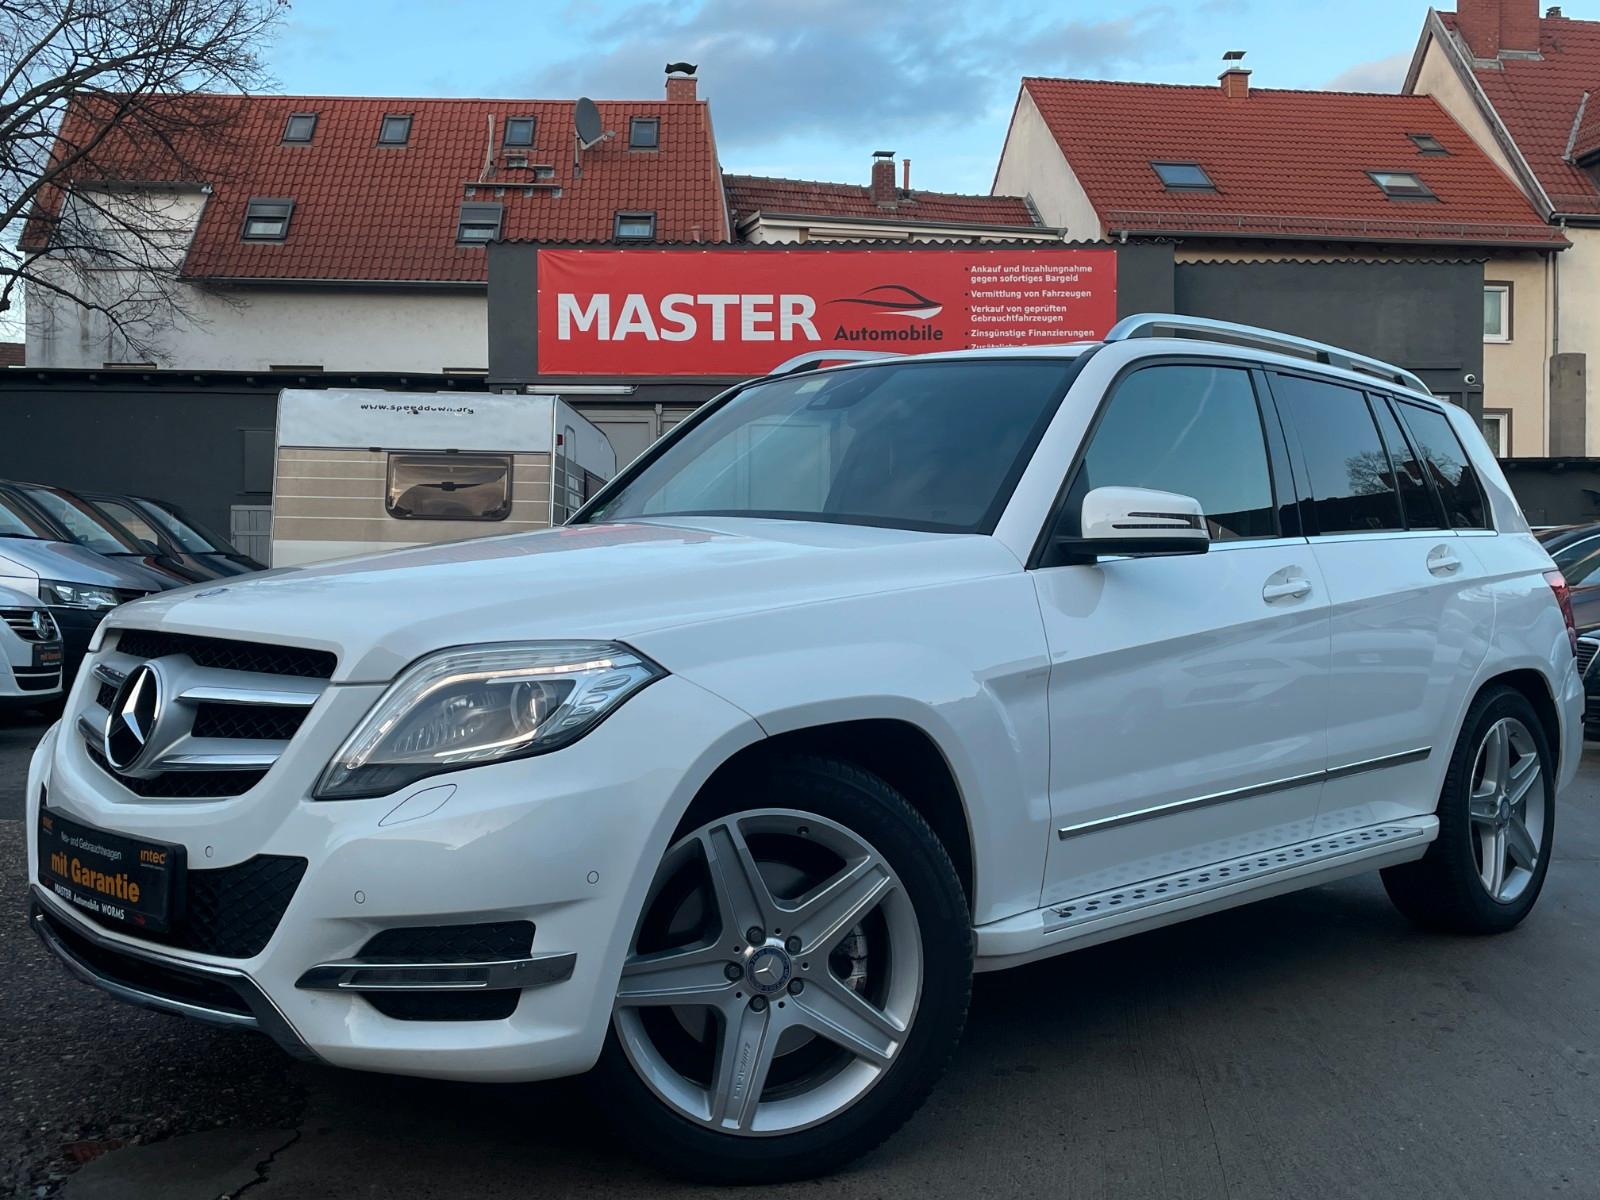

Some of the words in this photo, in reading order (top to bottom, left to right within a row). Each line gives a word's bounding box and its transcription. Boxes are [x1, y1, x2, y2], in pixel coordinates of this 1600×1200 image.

[971, 265, 1001, 273] Ankauf
[1003, 265, 1020, 273] und
[1022, 265, 1093, 274] Inzahlungnahme
[970, 276, 998, 284] gegen
[999, 275, 1043, 284] sofortiges
[1045, 274, 1079, 284] Bargeld
[970, 290, 1022, 299] Vermittlung
[1042, 290, 1092, 299] Fahrzeugen
[970, 305, 1005, 313] Verkauf
[1024, 305, 1067, 314] geprüften
[557, 293, 821, 341] MASTER
[970, 314, 1064, 323] Gebrauchtfahrzeugen
[833, 324, 943, 341] Automobile
[970, 329, 1026, 338] Zinsgünstige
[1028, 329, 1095, 338] Finanzierungen
[51, 851, 68, 878] mit
[71, 857, 140, 903] Garantie
[101, 903, 125, 920] WORMS
